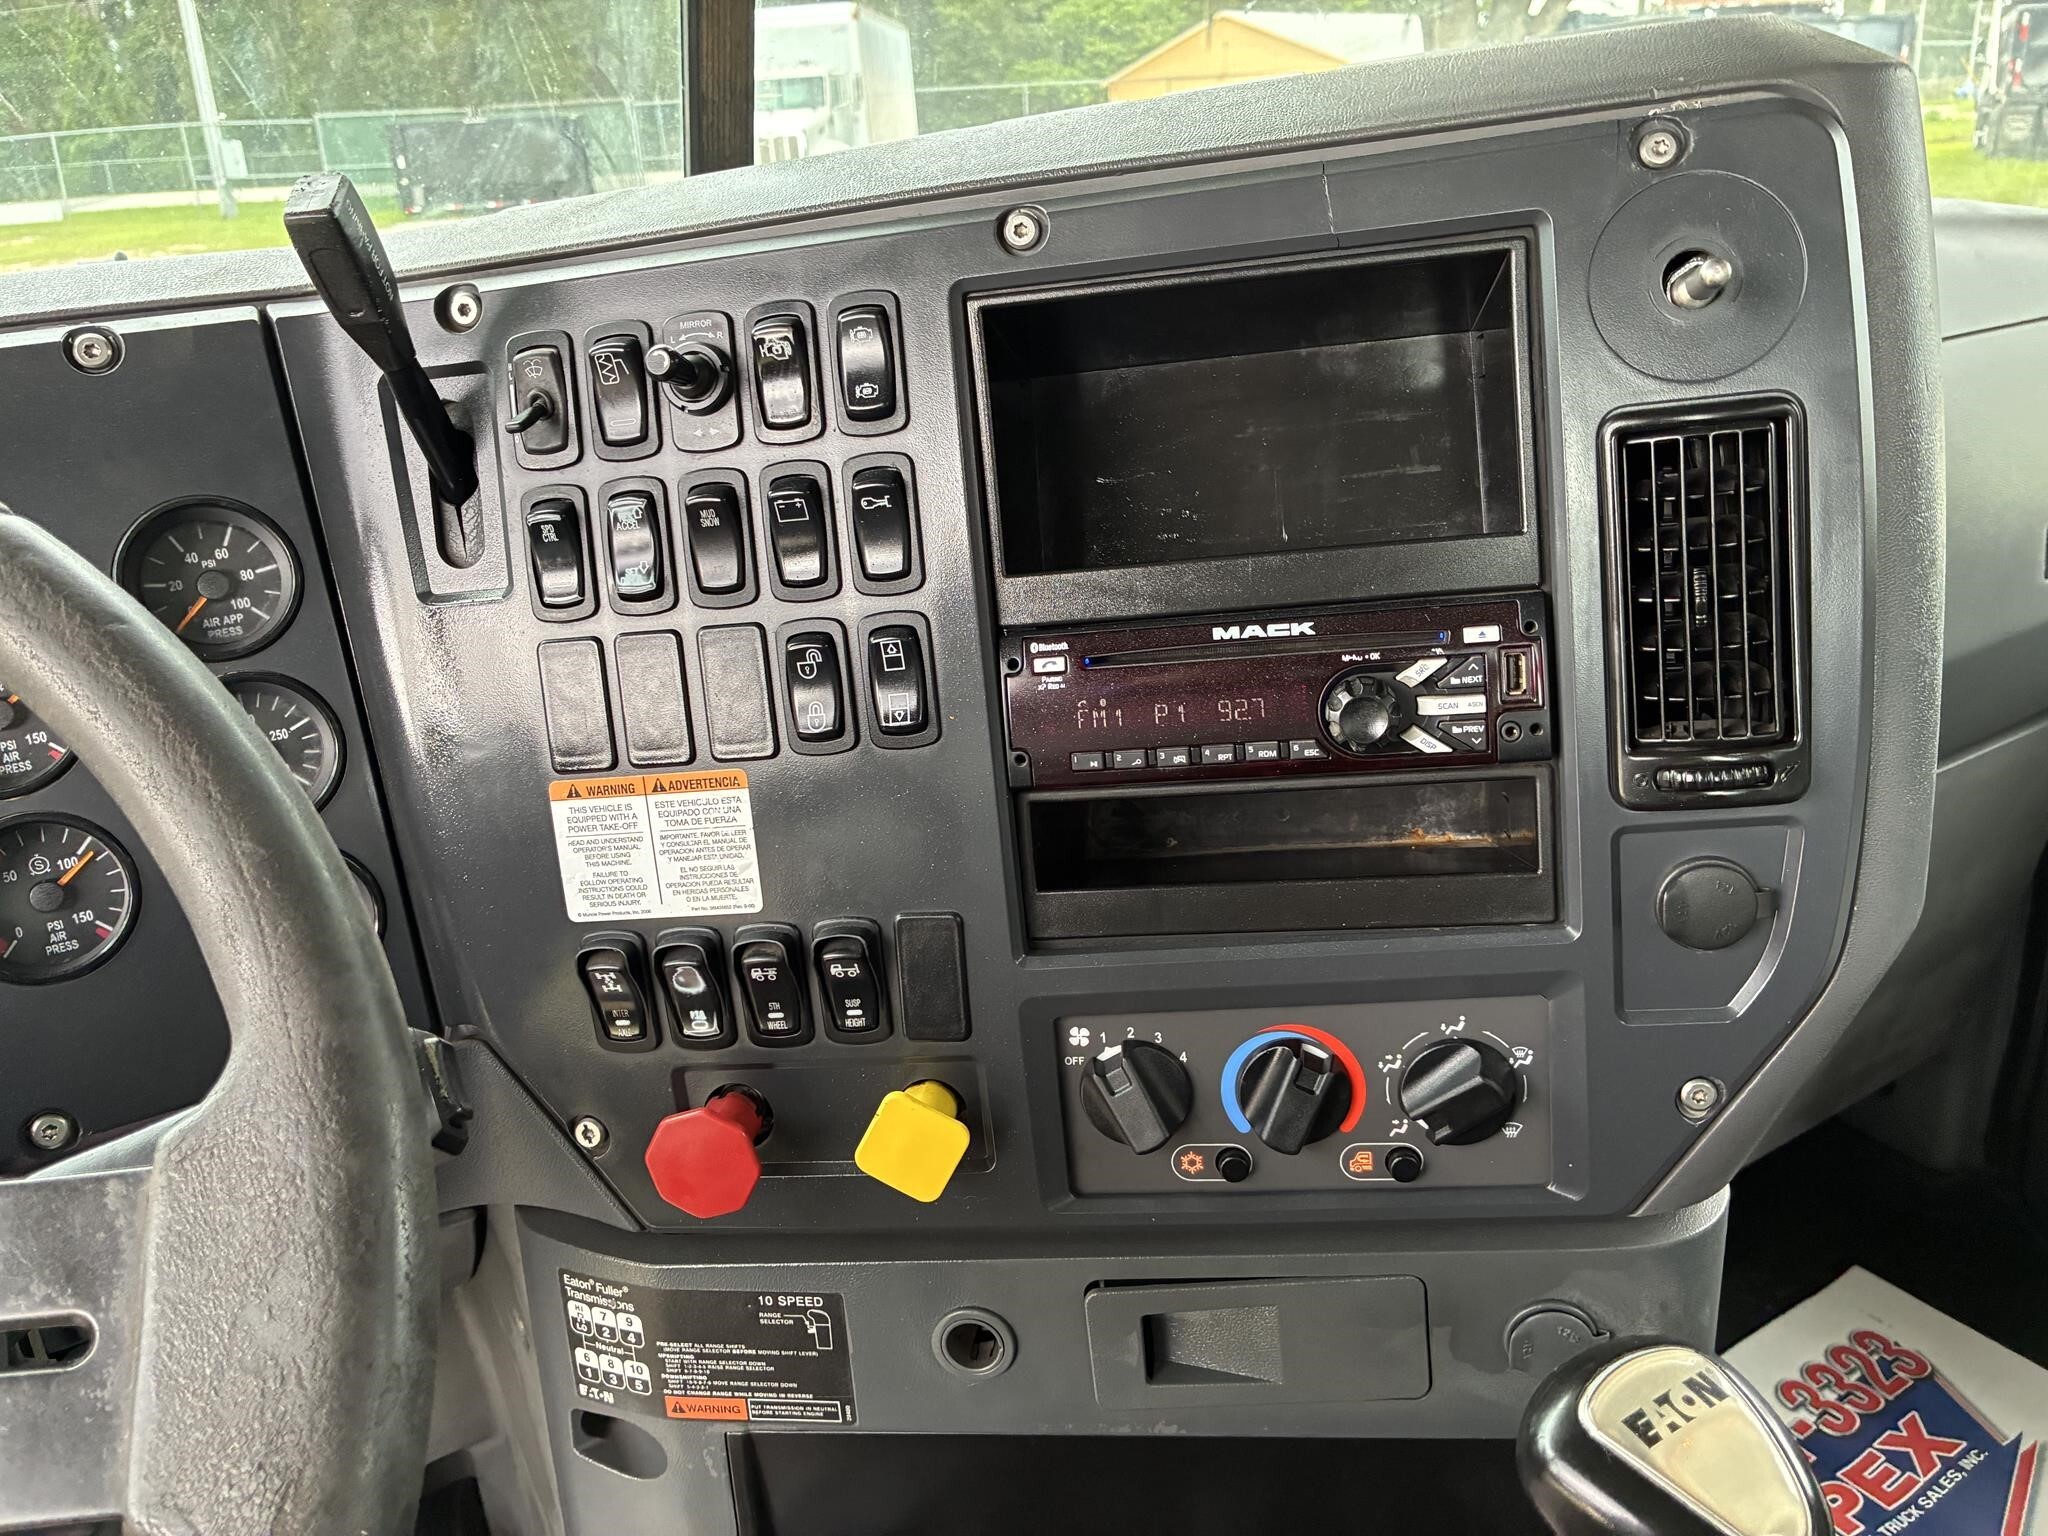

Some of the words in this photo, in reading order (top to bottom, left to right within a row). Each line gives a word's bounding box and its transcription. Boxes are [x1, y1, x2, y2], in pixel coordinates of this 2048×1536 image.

[680, 320, 712, 329] MIRROR
[670, 336, 676, 344] L
[716, 331, 723, 339] R
[700, 509, 715, 518] MUD
[616, 521, 640, 531] ACCEL
[700, 517, 720, 528] SNOW
[540, 524, 554, 534] SPD
[542, 532, 559, 542] CTRL
[184, 552, 198, 564] 40
[214, 548, 228, 560] 60
[202, 559, 216, 568] PSI
[240, 568, 254, 580] 80
[168, 580, 183, 592] 20
[230, 597, 250, 610] 100
[202, 616, 221, 628] AIR
[223, 613, 244, 626] APP
[208, 626, 244, 638] PRESS
[1212, 622, 1316, 640] MACK
[1039, 642, 1069, 651] Bluetooth
[1370, 652, 1380, 660] OK
[1415, 664, 1429, 678] SRC
[1462, 674, 1483, 684] NEXT
[1437, 702, 1459, 710] SCAN
[269, 728, 288, 741] 250
[1462, 725, 1485, 733] PREV
[24, 731, 48, 745] 150
[0, 740, 16, 752] PSI
[1294, 744, 1299, 752] 6
[1420, 738, 1437, 750] DISP
[3, 752, 20, 763] AIR
[1218, 753, 1232, 762] RPT
[668, 776, 740, 791] ADVERTENCIA
[586, 783, 636, 796] WARNING
[654, 800, 676, 809] ESTE
[721, 796, 742, 804] ESTA
[568, 806, 587, 814] THIS
[588, 804, 622, 813] VEHICLE
[658, 808, 700, 818] EQUIPADO
[702, 808, 720, 816] CON
[566, 815, 607, 824] EQUIPPED
[664, 819, 690, 828] TOMA
[691, 818, 703, 826] DE
[704, 816, 738, 824] FUERZA
[568, 825, 598, 833] POWER
[600, 822, 638, 831] TAKE-OFF
[56, 856, 78, 870] 100
[2, 870, 18, 883] 50
[580, 879, 606, 887] FOLLOW
[608, 877, 644, 885] OPERATING
[578, 886, 624, 894] INSTRUCTIONS
[626, 884, 648, 892] COULD
[615, 892, 636, 900] DEATH
[72, 910, 94, 924] 150
[46, 920, 64, 932] PSI
[15, 926, 23, 938] 0
[50, 931, 67, 944] AIR
[45, 940, 79, 956] PRESS
[768, 1002, 780, 1010] 5TH
[844, 998, 861, 1008] SUSP
[612, 1010, 630, 1018] INTER
[766, 1020, 788, 1030] WHEEL
[844, 1018, 866, 1028] HEIGHT
[1064, 1056, 1084, 1066] OFF
[1100, 1032, 1106, 1044] 1
[1126, 1026, 1135, 1038] 2
[1154, 1032, 1162, 1044] 3
[1180, 1051, 1188, 1062] 4
[564, 1286, 634, 1312] Transmissions
[758, 1296, 772, 1306] 10
[778, 1296, 823, 1306] SPEED
[574, 1304, 584, 1312] HI
[600, 1312, 606, 1321] 7
[626, 1317, 633, 1326] 9
[576, 1322, 588, 1332] LO
[602, 1326, 610, 1338] 2
[628, 1332, 636, 1343] 4
[595, 1342, 624, 1354] Neutral
[584, 1352, 590, 1362] 6
[608, 1359, 614, 1368] 8
[586, 1368, 592, 1378] 1
[630, 1365, 644, 1375] 10
[608, 1374, 618, 1385] 3
[634, 1380, 644, 1390] 5
[686, 1404, 740, 1414] WARNING
[1620, 1370, 1730, 1448] EATON
[1820, 1411, 1967, 1536] PEX
[1877, 1504, 1925, 1536] TRUCK
[1918, 1468, 1968, 1510] SALES,
[1958, 1448, 1989, 1473] INC.
